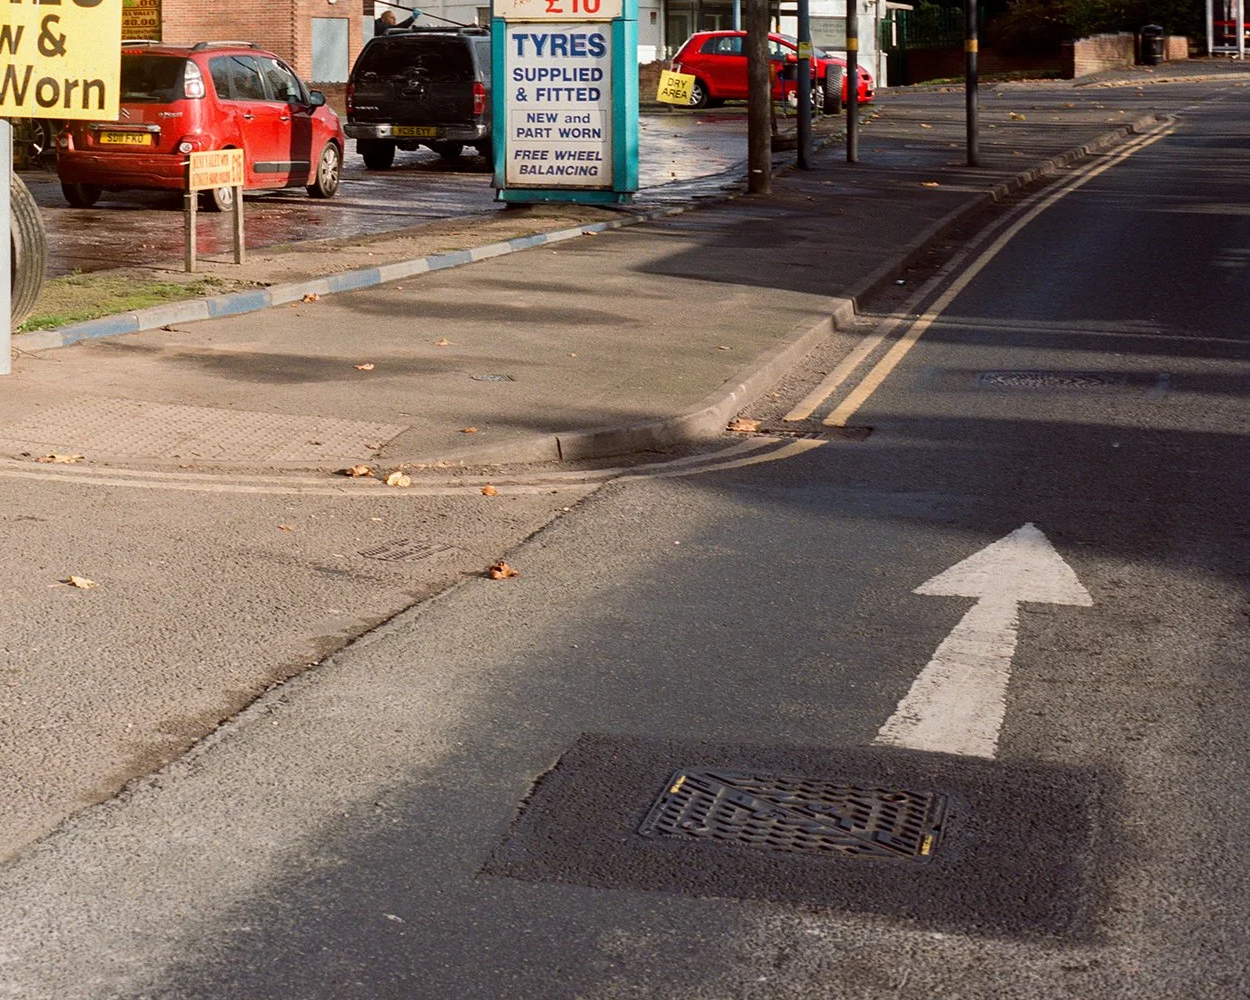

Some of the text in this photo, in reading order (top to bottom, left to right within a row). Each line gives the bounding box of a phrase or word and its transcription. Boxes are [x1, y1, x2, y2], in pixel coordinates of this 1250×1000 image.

[37, 13, 67, 58] &
[512, 33, 607, 58] TYRES
[513, 67, 603, 82] SUPPLIED
[667, 77, 687, 88] DRY
[516, 87, 601, 101] & FITTED
[661, 87, 687, 99] AREA
[527, 113, 590, 124] NEW and
[516, 128, 601, 138] PART WORN
[514, 150, 603, 161] FREE WHEEL
[519, 165, 598, 176] BALANCING
